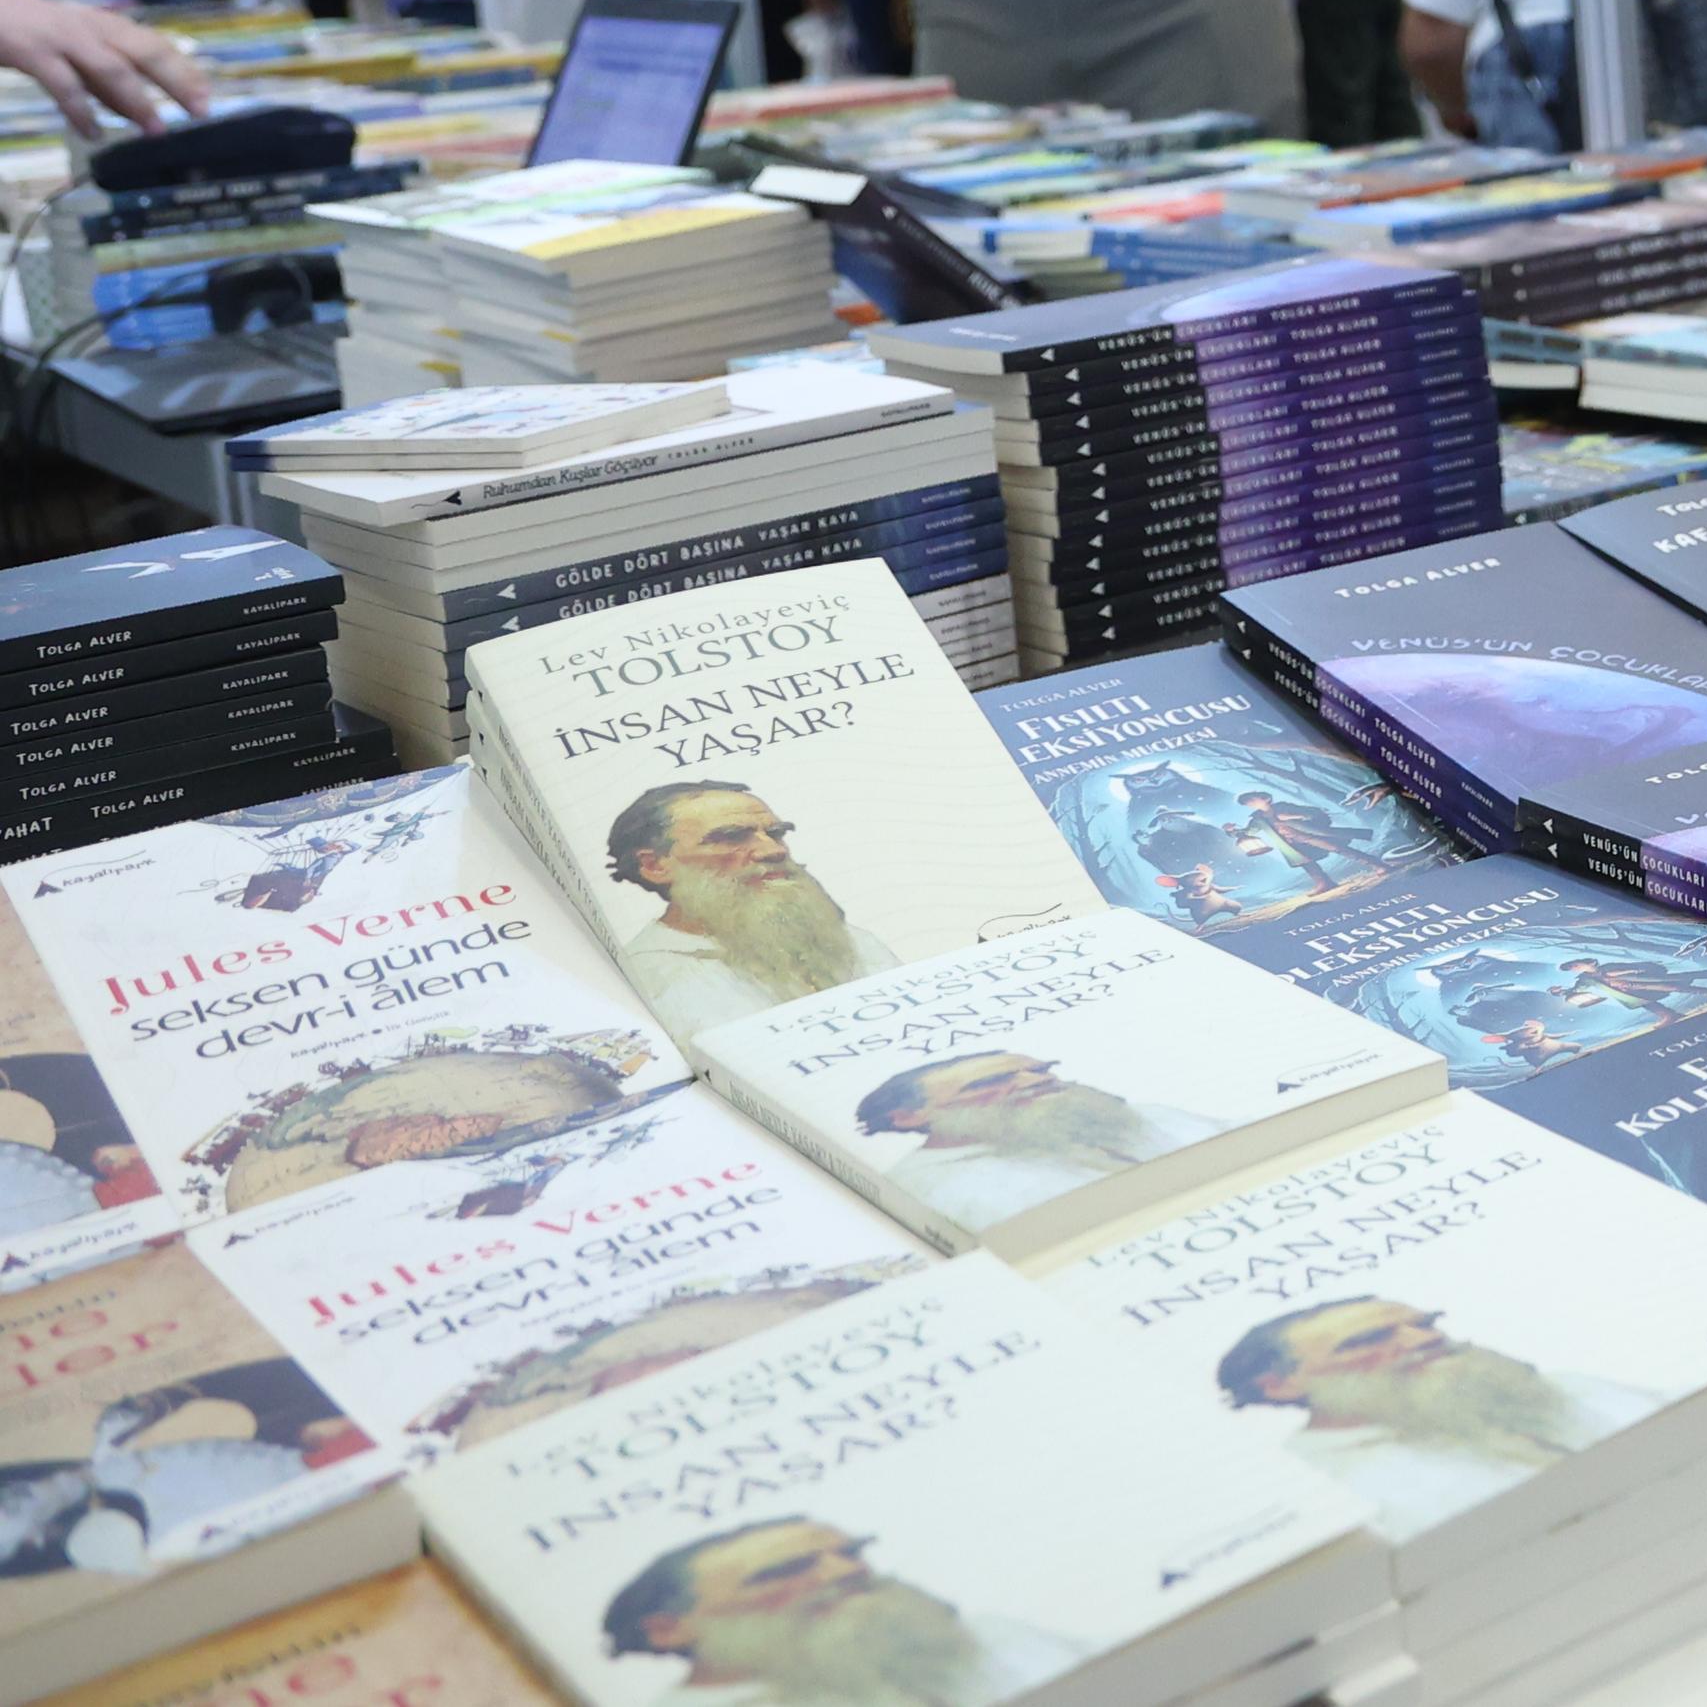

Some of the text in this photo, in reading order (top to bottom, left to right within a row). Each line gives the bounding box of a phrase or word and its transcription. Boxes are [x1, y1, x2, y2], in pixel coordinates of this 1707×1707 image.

[554, 510, 860, 589] GÖLDE DÖRT BAŞINA YAŞAR KAYA
[821, 538, 863, 559] KAYA
[1334, 557, 1502, 600] TOLGA ALVER
[37, 630, 132, 659] TOLGA ALVER
[538, 592, 851, 675] Lev Nikolayeviç
[571, 614, 845, 698] TOLSTOY
[29, 667, 125, 696] TOLGA ALVER
[1000, 677, 1124, 714] TOLGA ALVER
[11, 706, 109, 736] TOLGA ALVER
[553, 653, 915, 759] İNSAN NEYLE
[1015, 693, 1153, 743] FISILTI
[16, 736, 114, 766] TOLGA ALVER
[654, 700, 857, 769] YAŞAR?
[19, 770, 118, 800] TOLGA ALVER
[1034, 754, 1119, 786] ANNEMİN
[91, 787, 185, 819] TOLGA ALVER
[1583, 832, 1638, 862] VENÜS'ÜN
[1642, 854, 1705, 888] ÇOCUKLARI
[1587, 857, 1643, 888] VENÜS'ÜN
[1284, 893, 1417, 937] TOLGA ALVER
[1304, 903, 1452, 955] FISILTI
[98, 883, 518, 1016] Jules Verne
[1331, 951, 1424, 987] ANNEMİN
[130, 918, 533, 1043] seksen günde
[802, 941, 1094, 1036] TOLSTOY
[987, 948, 1175, 1012] NEYLE
[195, 996, 360, 1059] devr-i
[371, 959, 511, 1012] âlem
[768, 1005, 838, 1034] Lev
[900, 983, 1116, 1057] YAŞAR?
